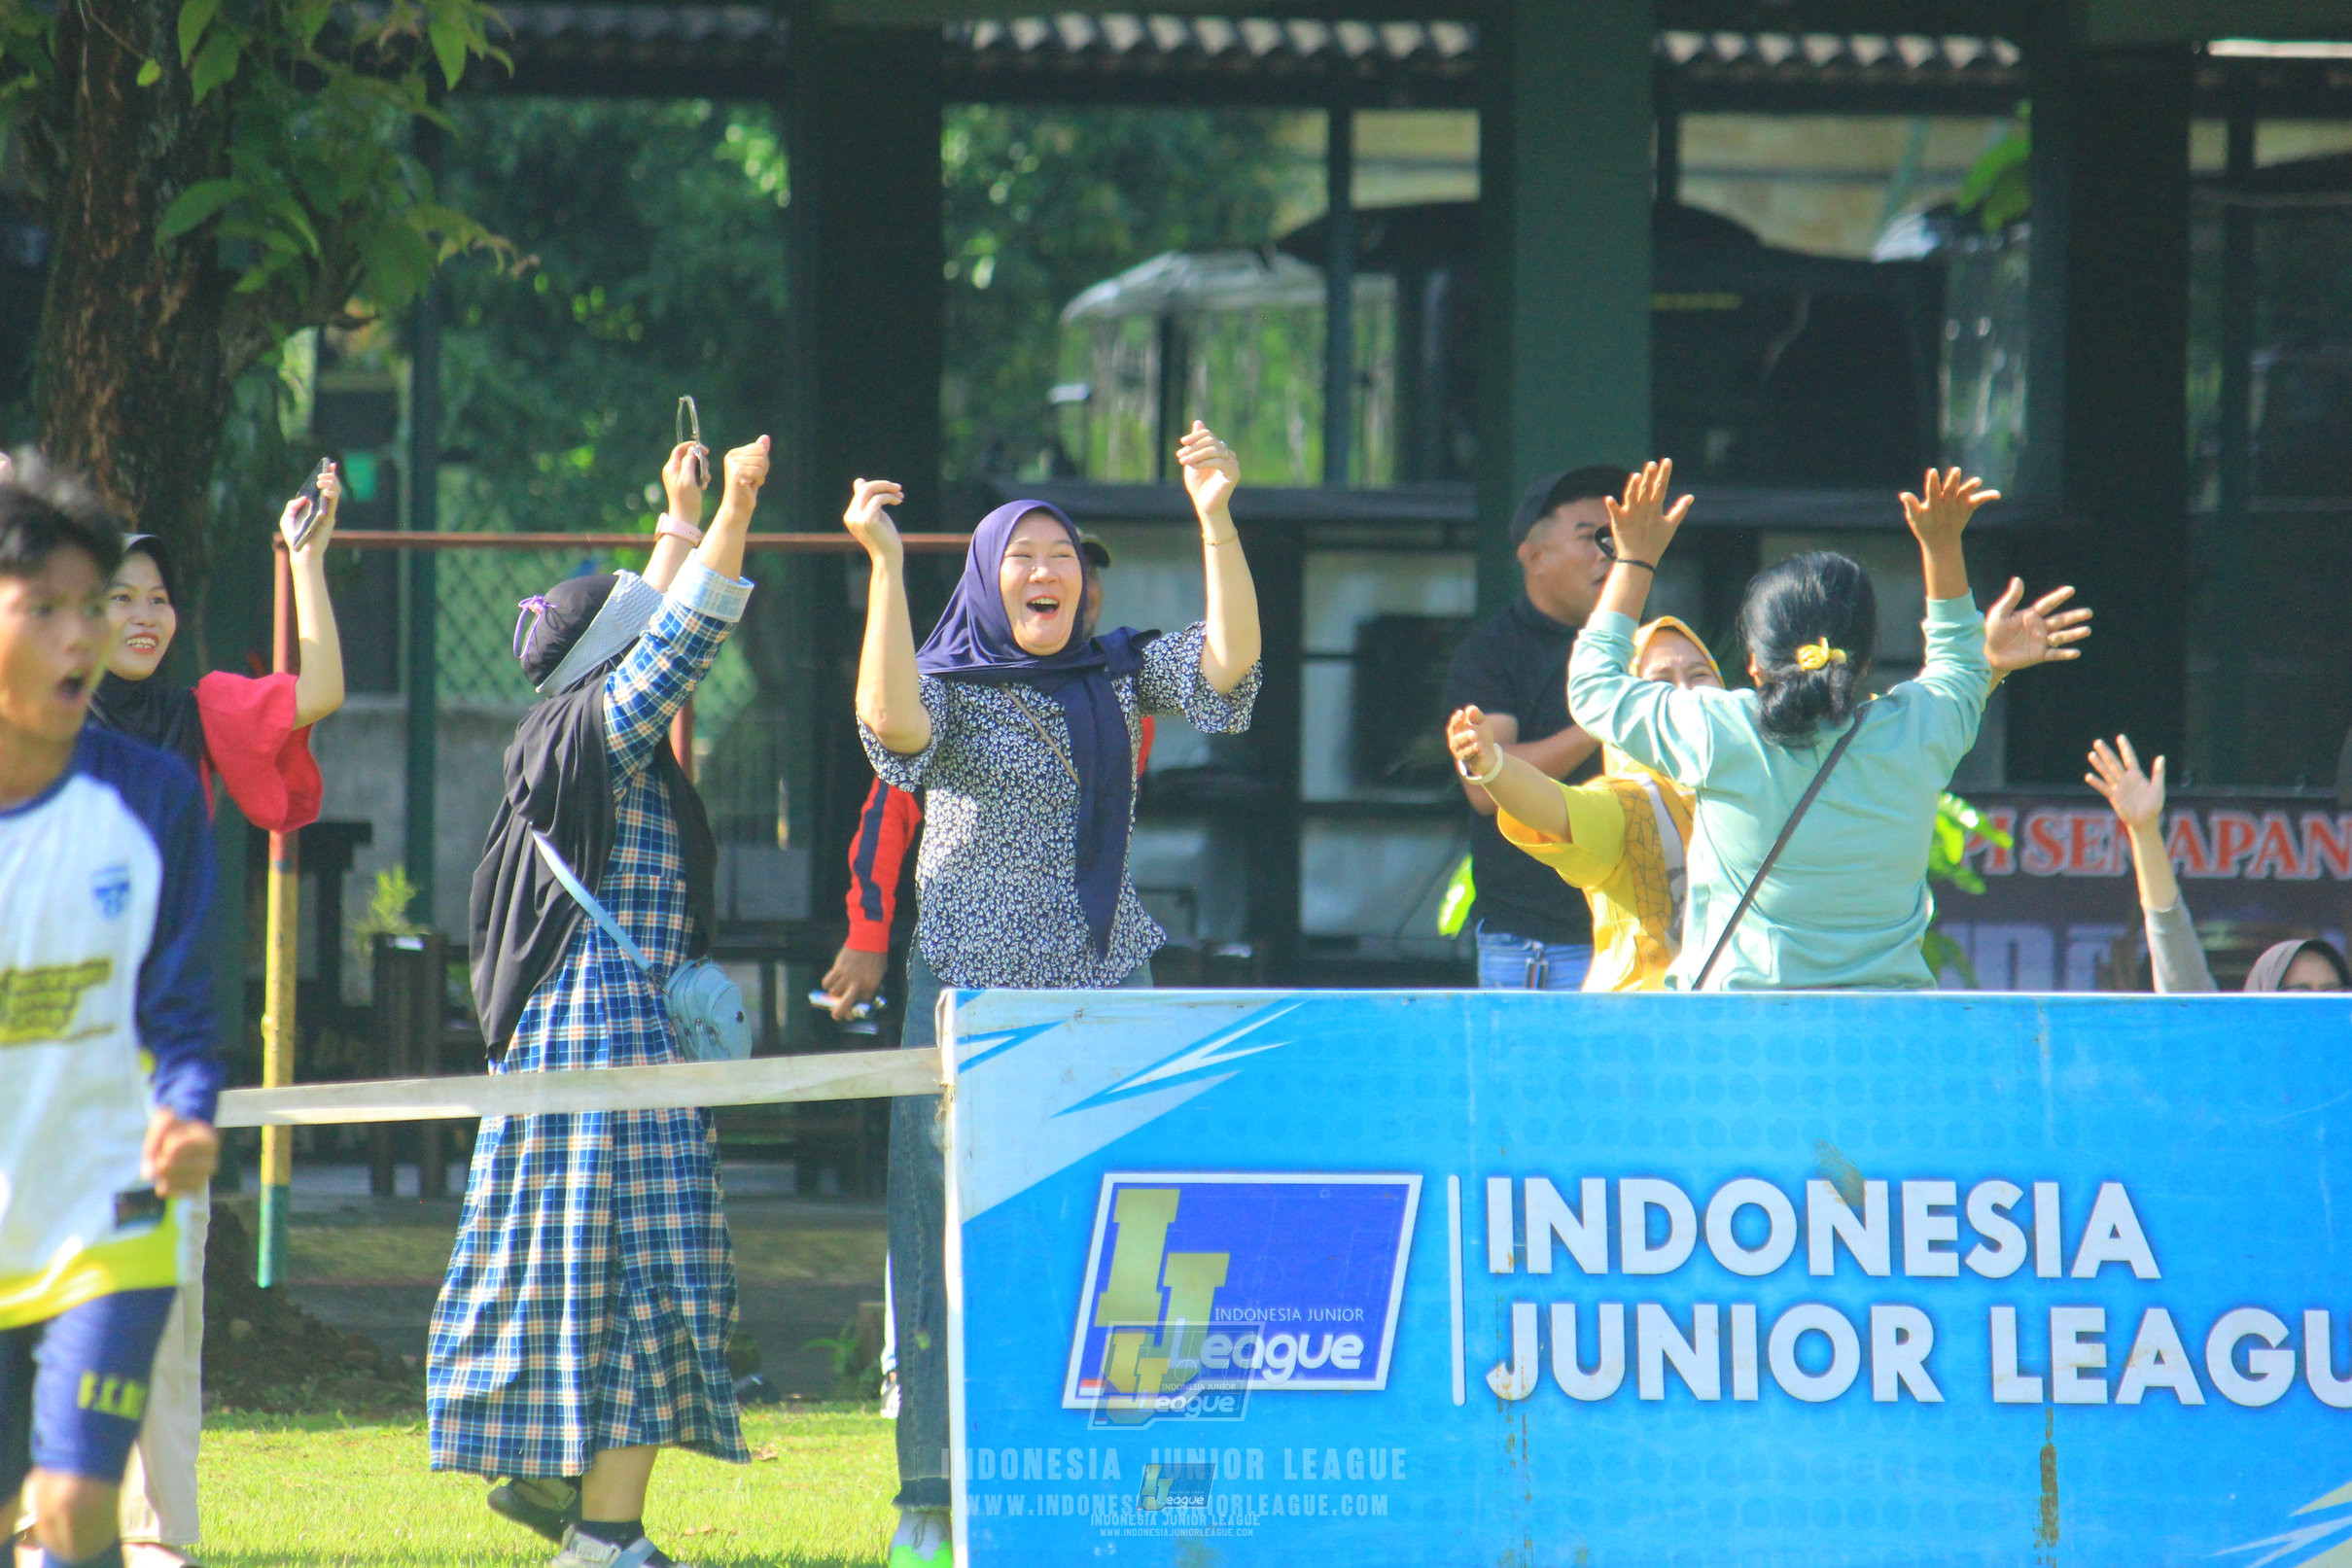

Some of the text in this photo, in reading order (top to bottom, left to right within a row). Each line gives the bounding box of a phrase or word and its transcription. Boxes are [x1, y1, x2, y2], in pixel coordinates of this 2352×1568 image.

[1488, 1177, 2161, 1279] INDONESIA
[1169, 1317, 1364, 1384] League
[1215, 1308, 1364, 1322] INDONESIA JUNIOR
[1486, 1304, 2352, 1409] JUNIOR LEAGU
